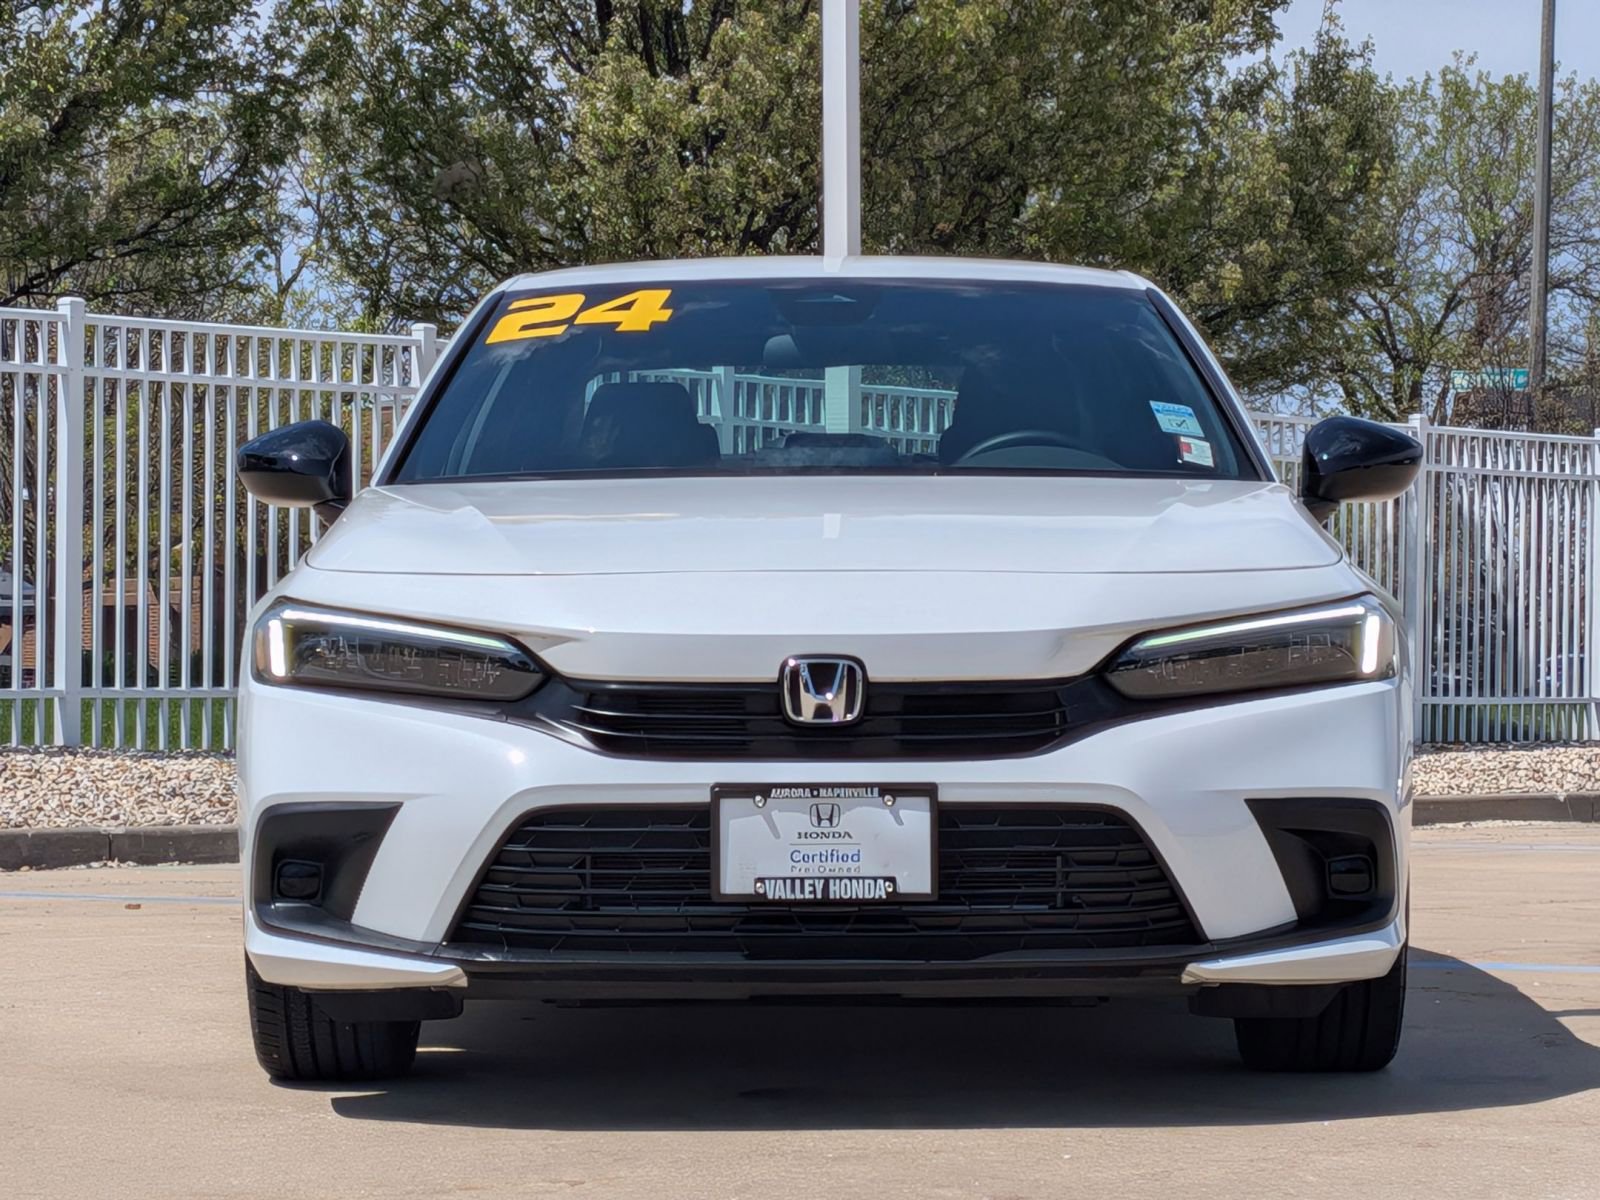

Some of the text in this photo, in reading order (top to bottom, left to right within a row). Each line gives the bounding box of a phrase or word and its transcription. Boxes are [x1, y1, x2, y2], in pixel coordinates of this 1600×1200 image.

[485, 289, 673, 345] 24
[770, 787, 811, 798] AURORA
[796, 831, 853, 840] HONDA
[790, 848, 861, 863] Certified
[765, 879, 887, 899] VALLEY HONDA
